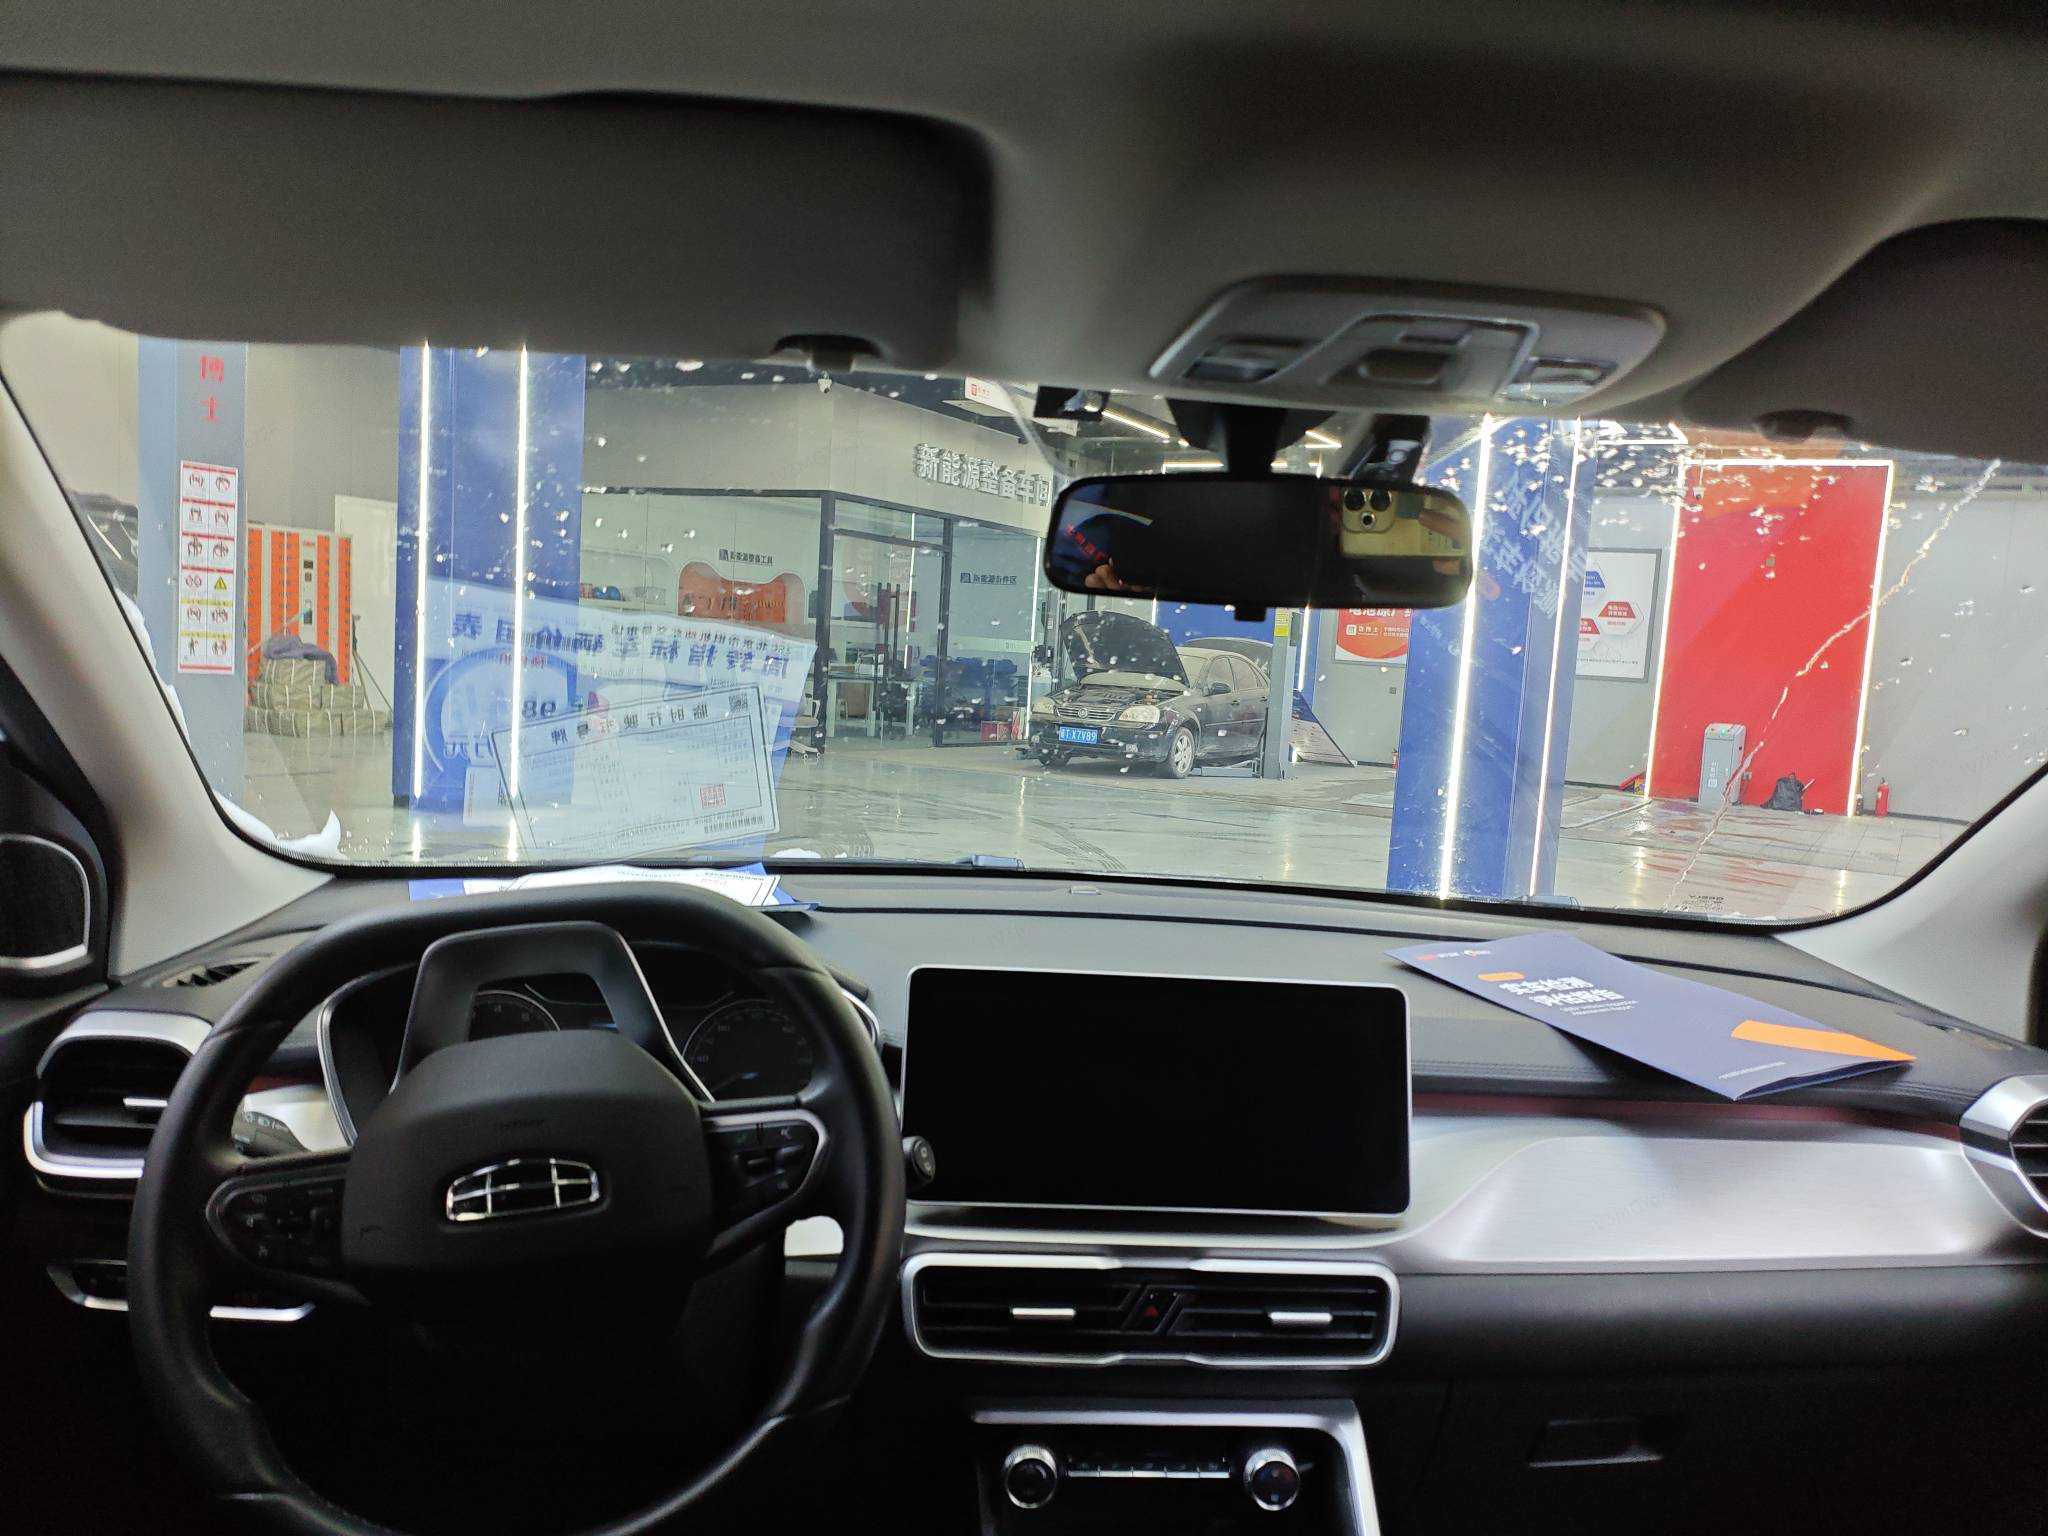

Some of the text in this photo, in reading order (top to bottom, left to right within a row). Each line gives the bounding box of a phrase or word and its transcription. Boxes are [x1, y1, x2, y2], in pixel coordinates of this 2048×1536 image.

[912, 442, 1050, 507] 新能源整备车间
